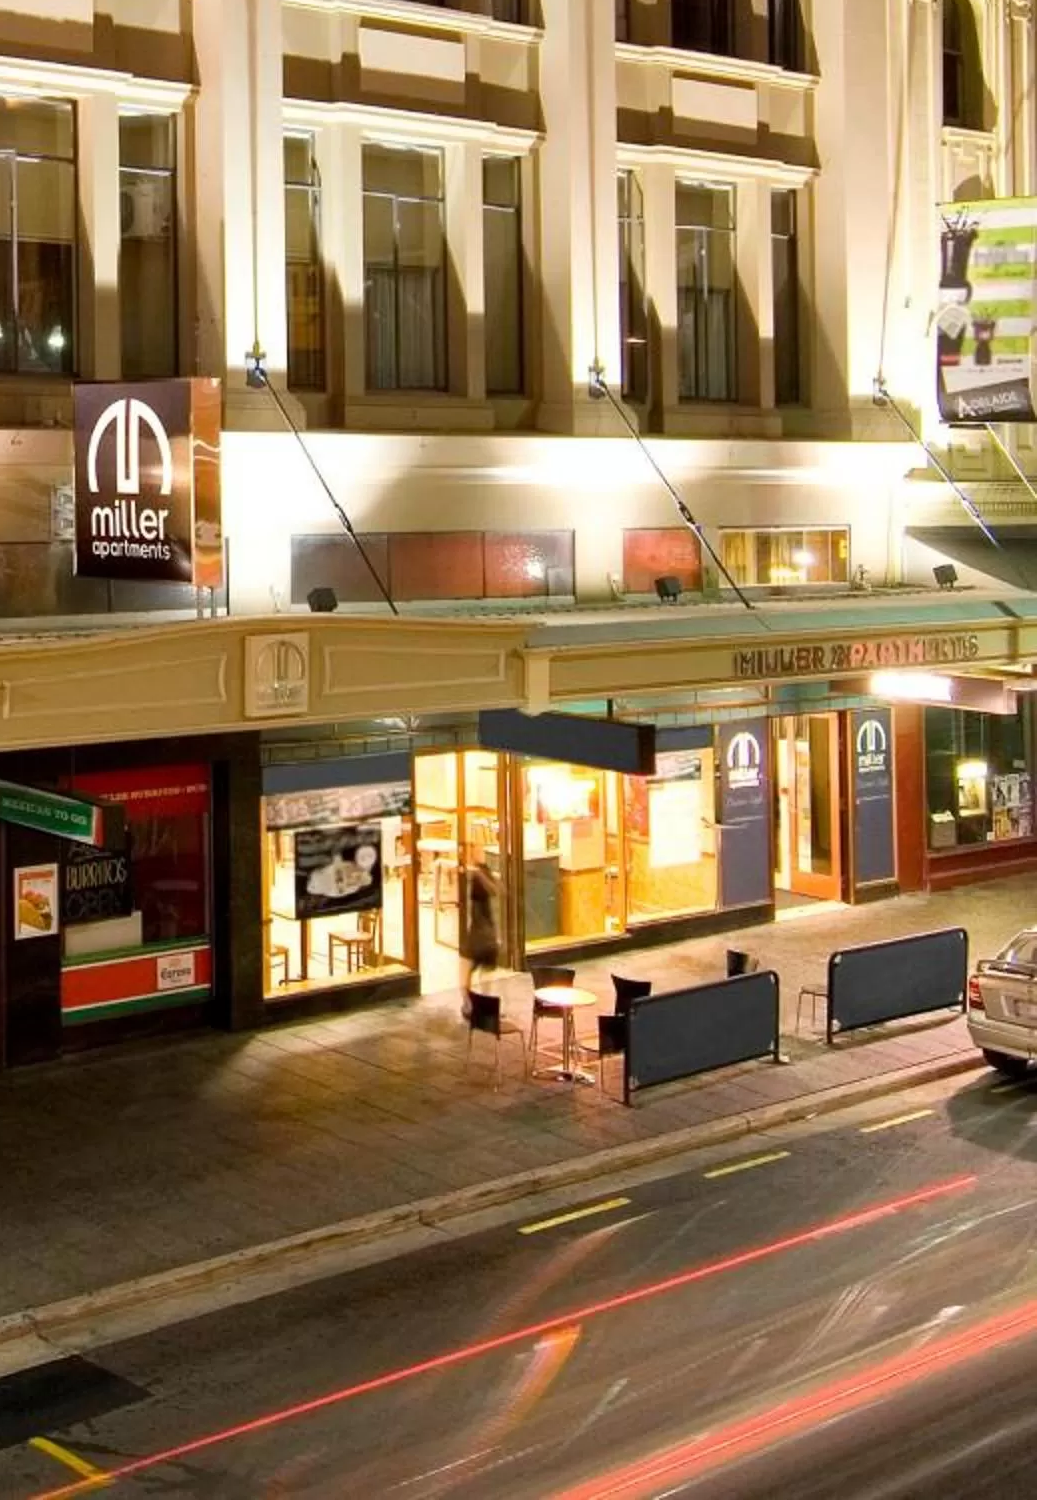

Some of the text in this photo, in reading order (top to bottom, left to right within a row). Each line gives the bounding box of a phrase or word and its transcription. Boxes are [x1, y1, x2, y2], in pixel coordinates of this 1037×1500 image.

[91, 500, 169, 540] miller
[92, 540, 171, 561] apartments
[732, 634, 979, 678] MILLER APARTMENTS
[54, 808, 70, 822] TO
[66, 856, 128, 891] BURRITOS
